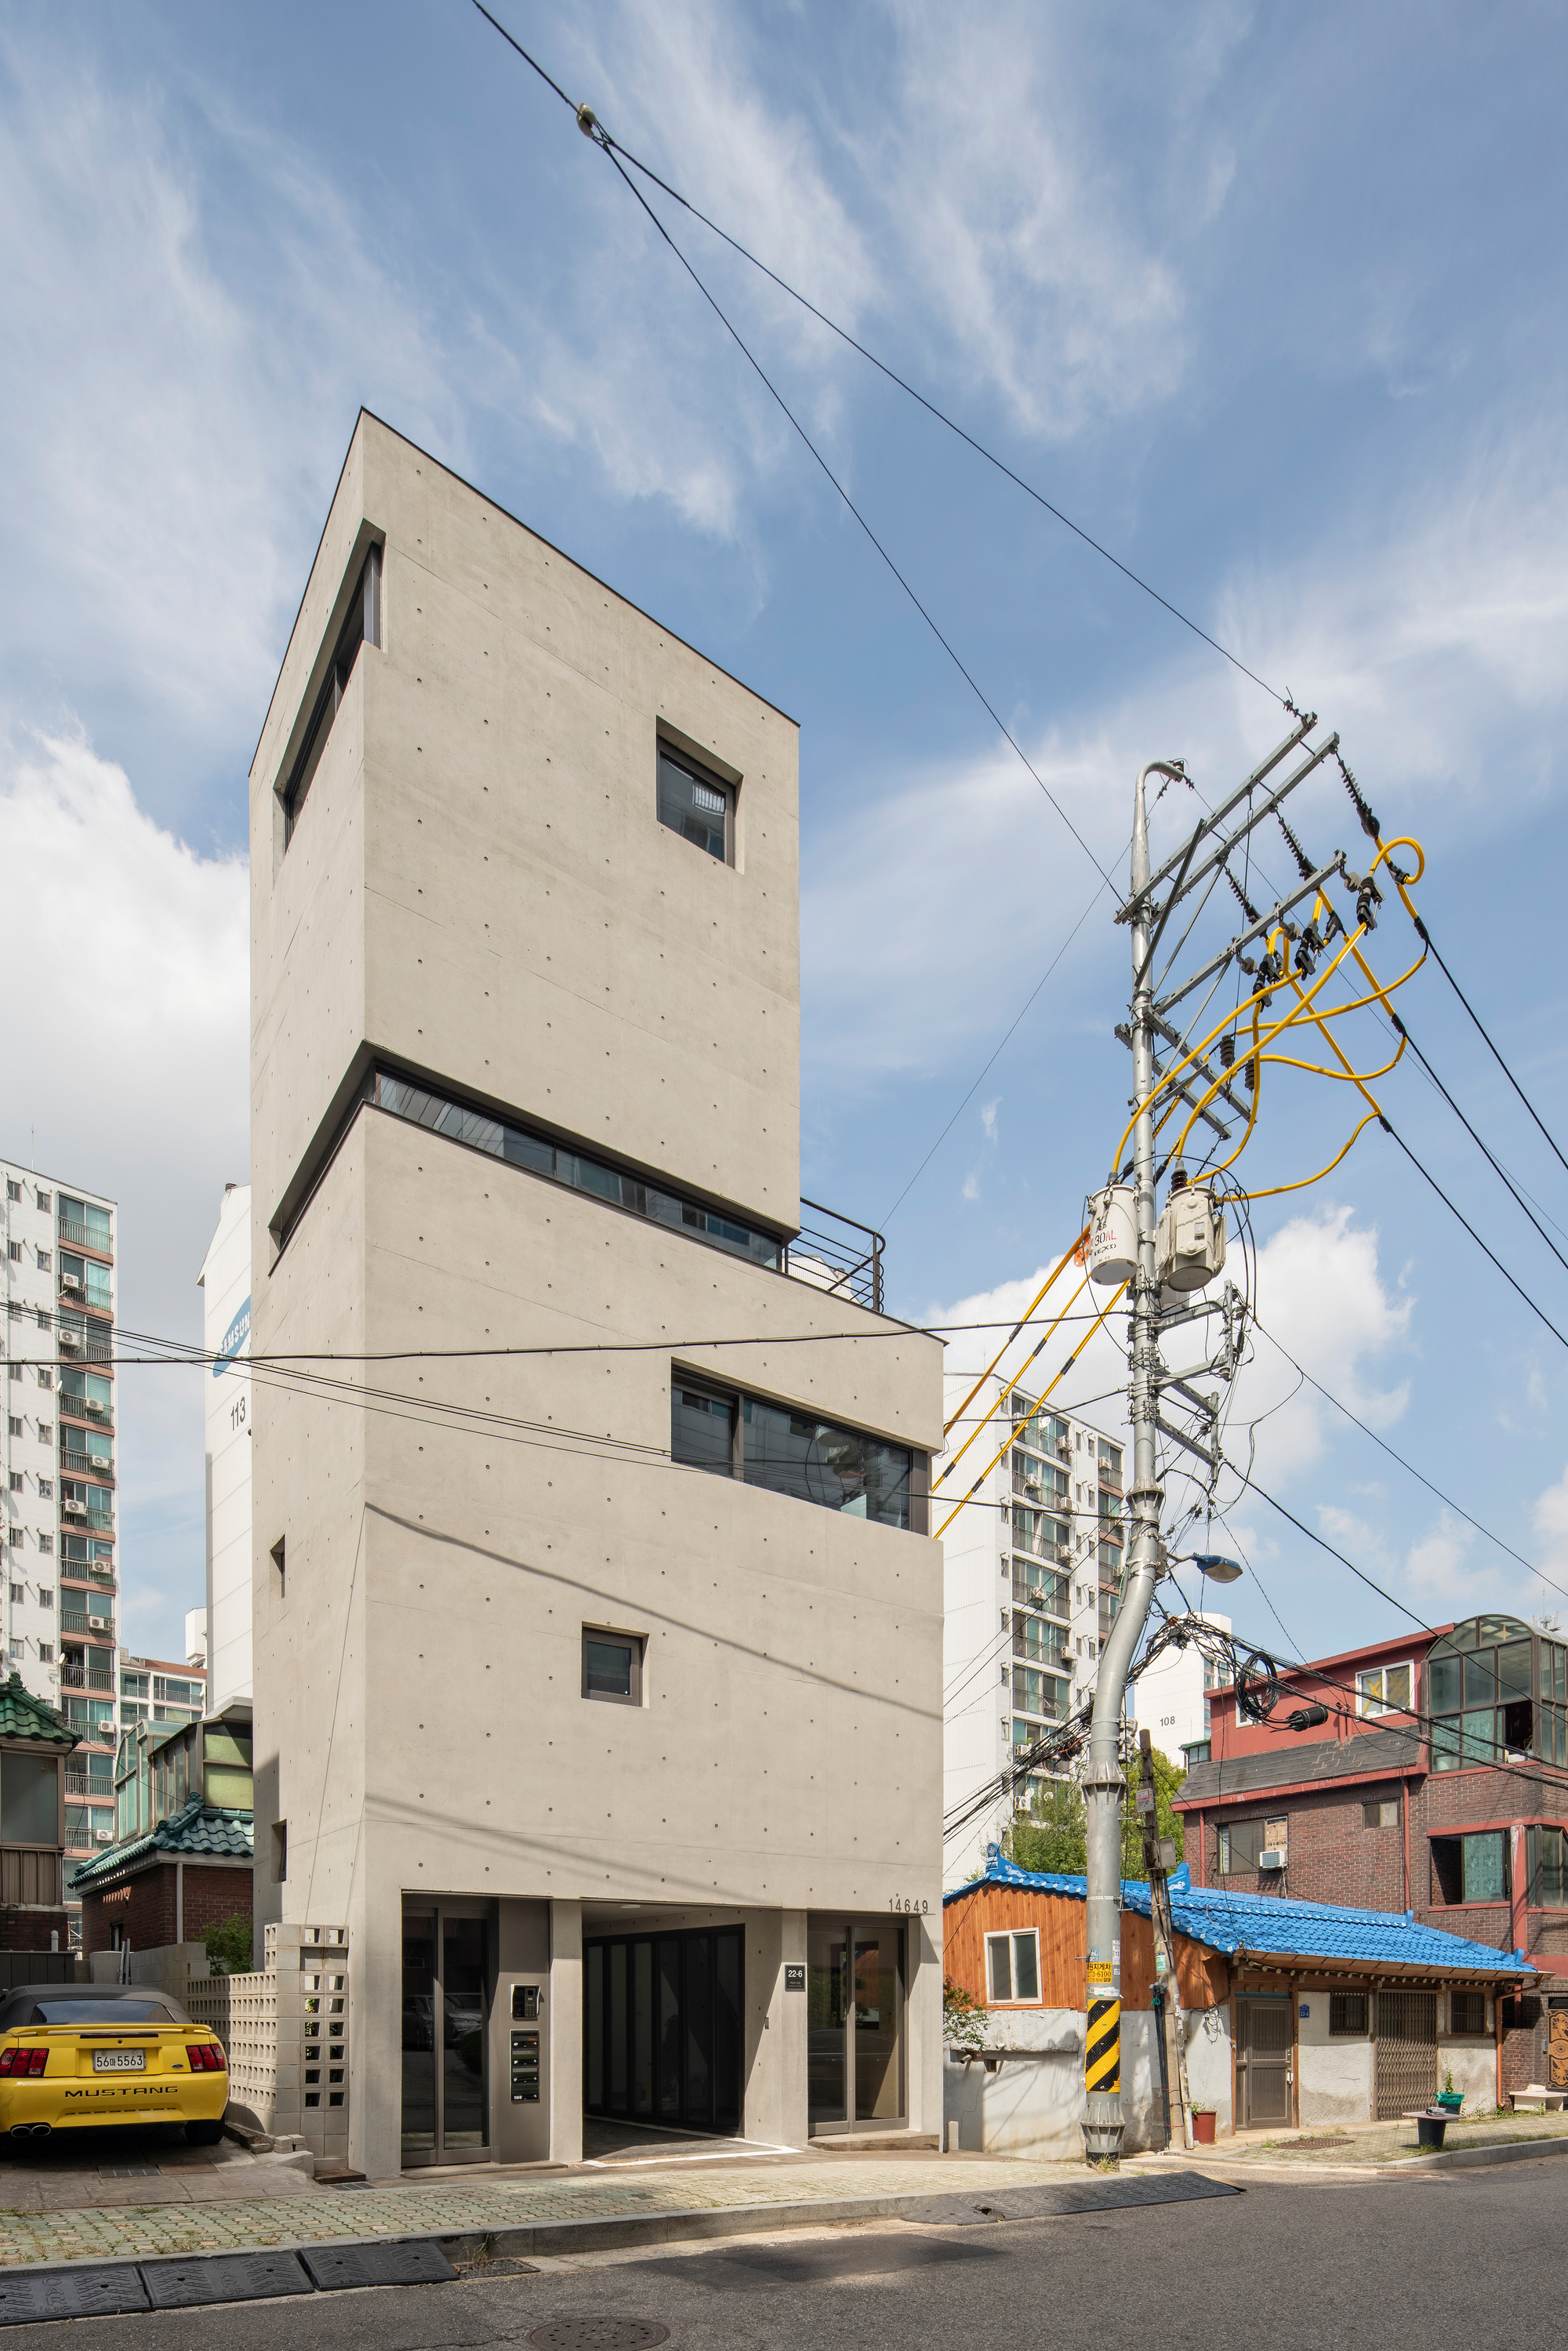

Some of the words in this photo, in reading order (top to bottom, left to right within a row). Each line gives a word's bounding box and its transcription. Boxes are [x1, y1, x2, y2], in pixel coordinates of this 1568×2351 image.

[230, 1396, 245, 1431] 113
[1160, 1715, 1175, 1727] 108
[888, 1898, 928, 1914] 14649
[788, 1969, 803, 1978] 22-6
[96, 2055, 143, 2068] 56마5563
[65, 2086, 179, 2098] MUSTANG
[42, 2277, 67, 2306] CAR
[45, 2305, 72, 2314] UP
